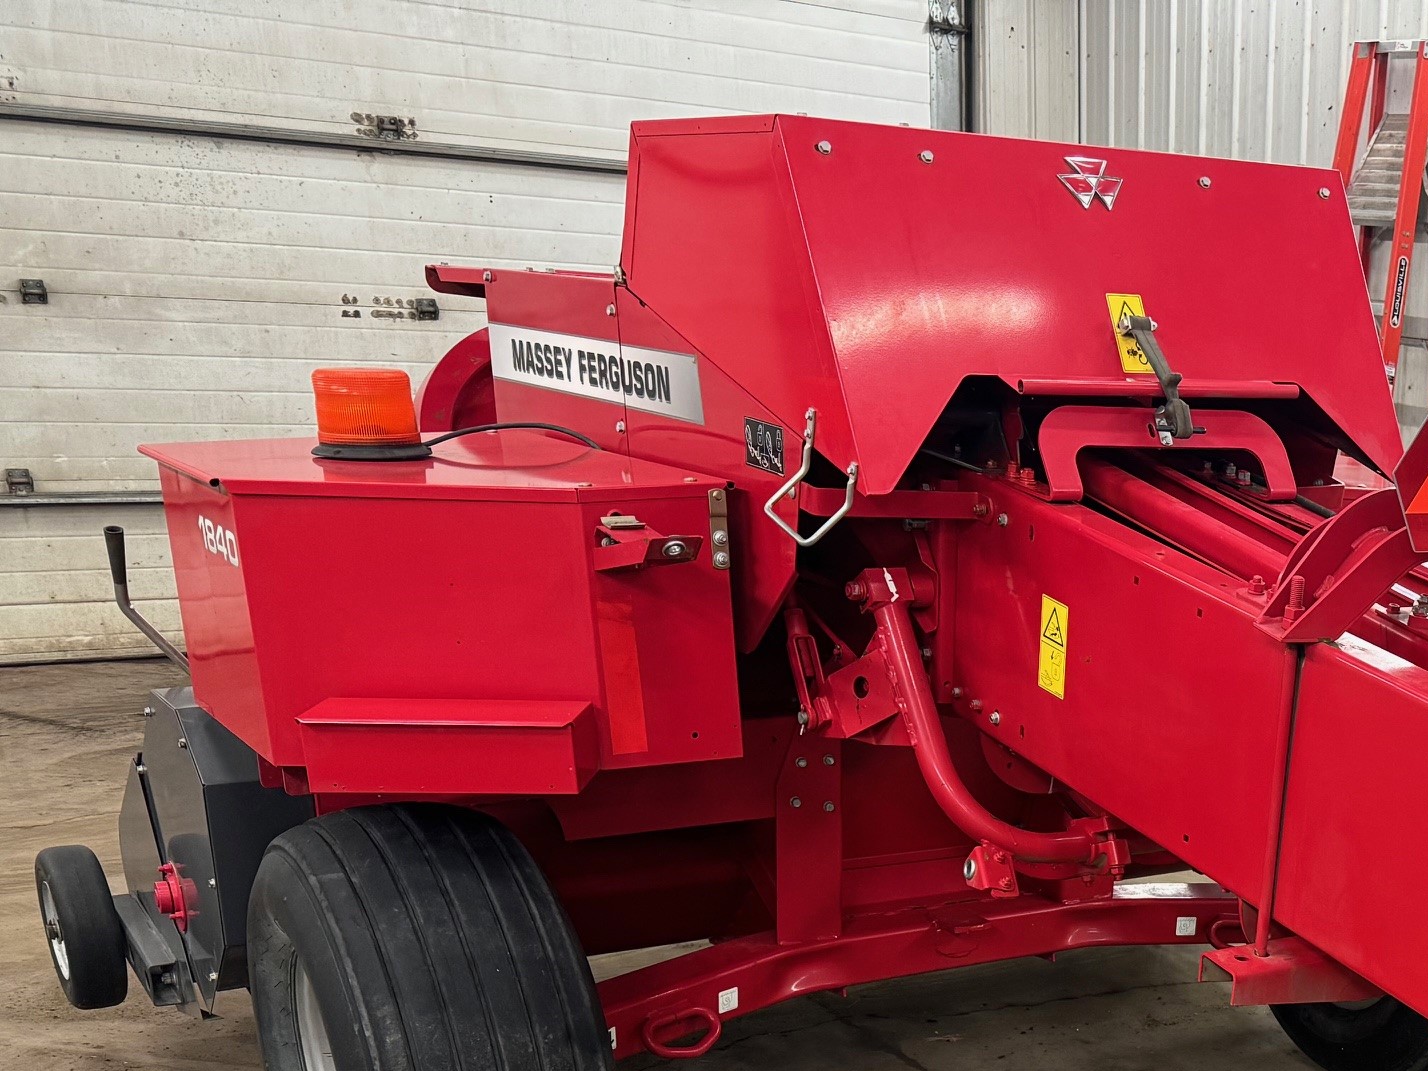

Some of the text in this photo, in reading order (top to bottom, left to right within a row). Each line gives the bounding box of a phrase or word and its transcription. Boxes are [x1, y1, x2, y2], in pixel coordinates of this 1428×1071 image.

[1393, 258, 1406, 316] LOUISVILLE
[511, 338, 671, 404] MASSEY FERGUSON
[198, 514, 239, 567] 1840
